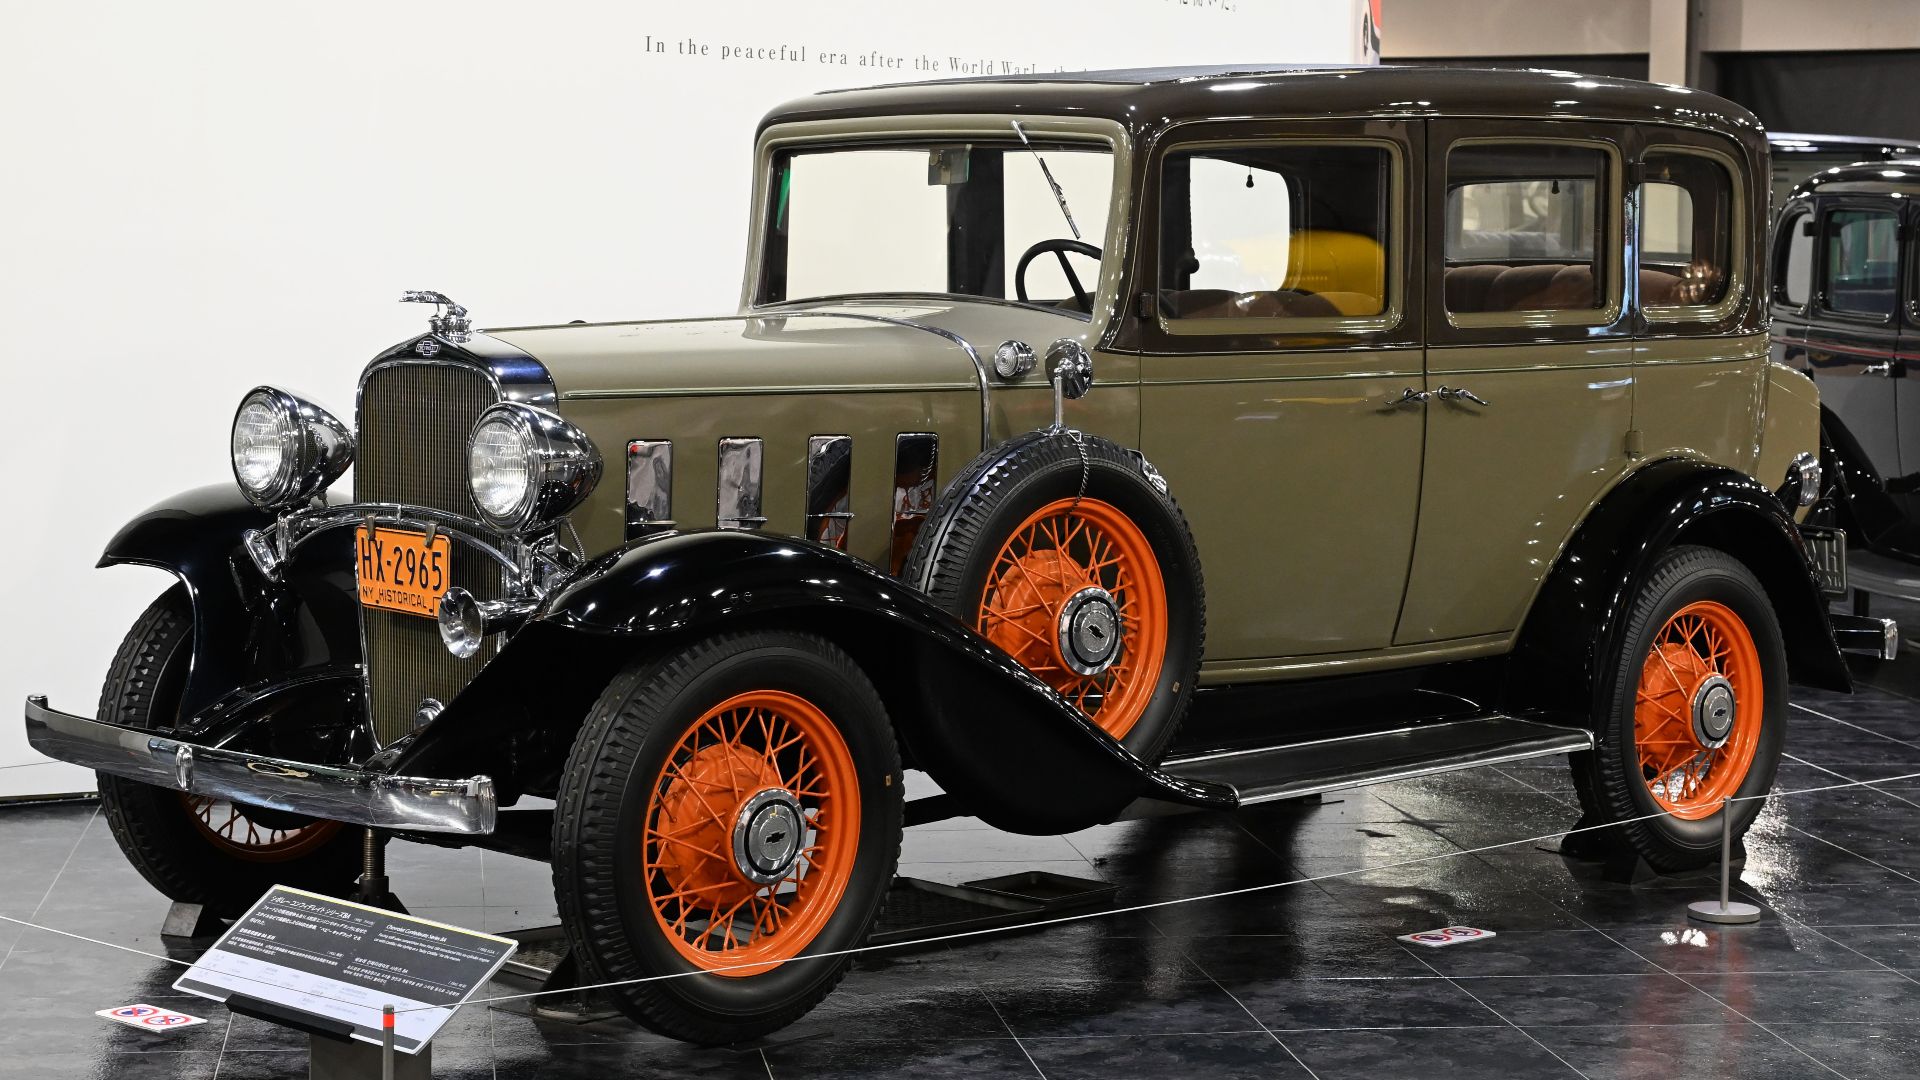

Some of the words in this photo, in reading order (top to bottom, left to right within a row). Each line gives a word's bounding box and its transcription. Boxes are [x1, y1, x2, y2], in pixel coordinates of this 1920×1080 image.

[644, 35, 665, 53] In
[678, 38, 709, 55] the
[721, 44, 806, 62] peaceful
[819, 51, 848, 65] era
[859, 51, 904, 69] after
[915, 55, 939, 72] the
[949, 57, 993, 76] World
[361, 537, 442, 591] HX-2965
[362, 585, 374, 599] NY
[379, 588, 427, 609] HISTORICAL
